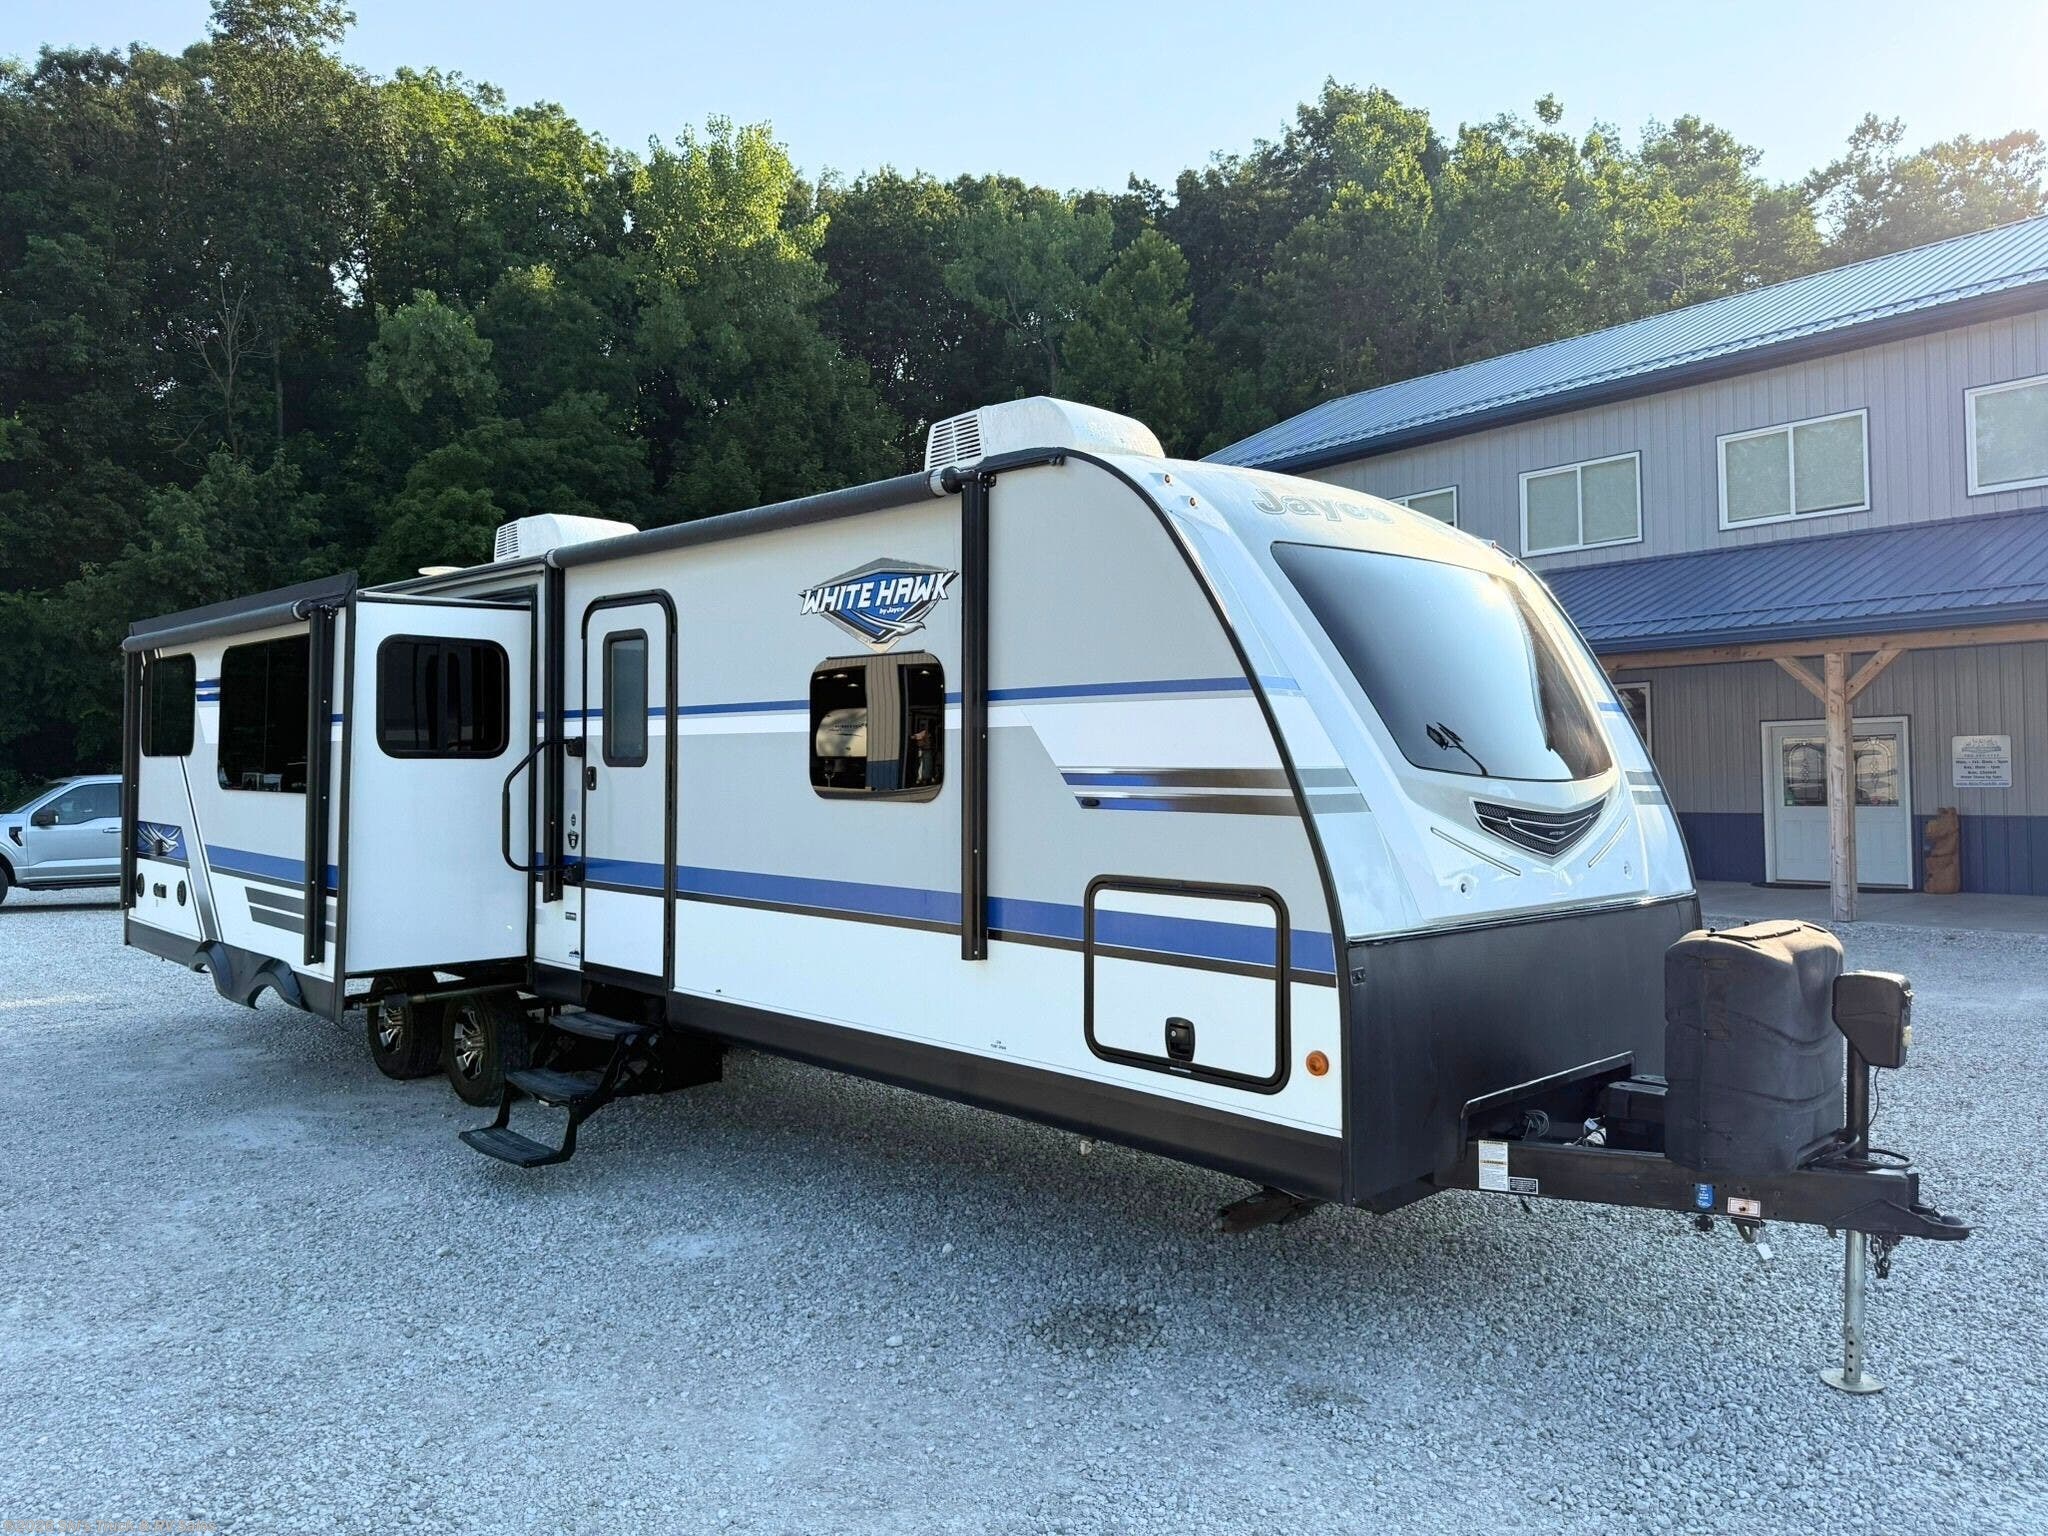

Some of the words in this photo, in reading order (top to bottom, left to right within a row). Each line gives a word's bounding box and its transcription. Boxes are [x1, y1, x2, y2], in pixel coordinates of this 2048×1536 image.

[1252, 488, 1394, 525] Jayco
[799, 581, 876, 615] WHITE
[875, 570, 958, 606] HAWK
[879, 607, 887, 615] by
[886, 606, 905, 615] Jayco
